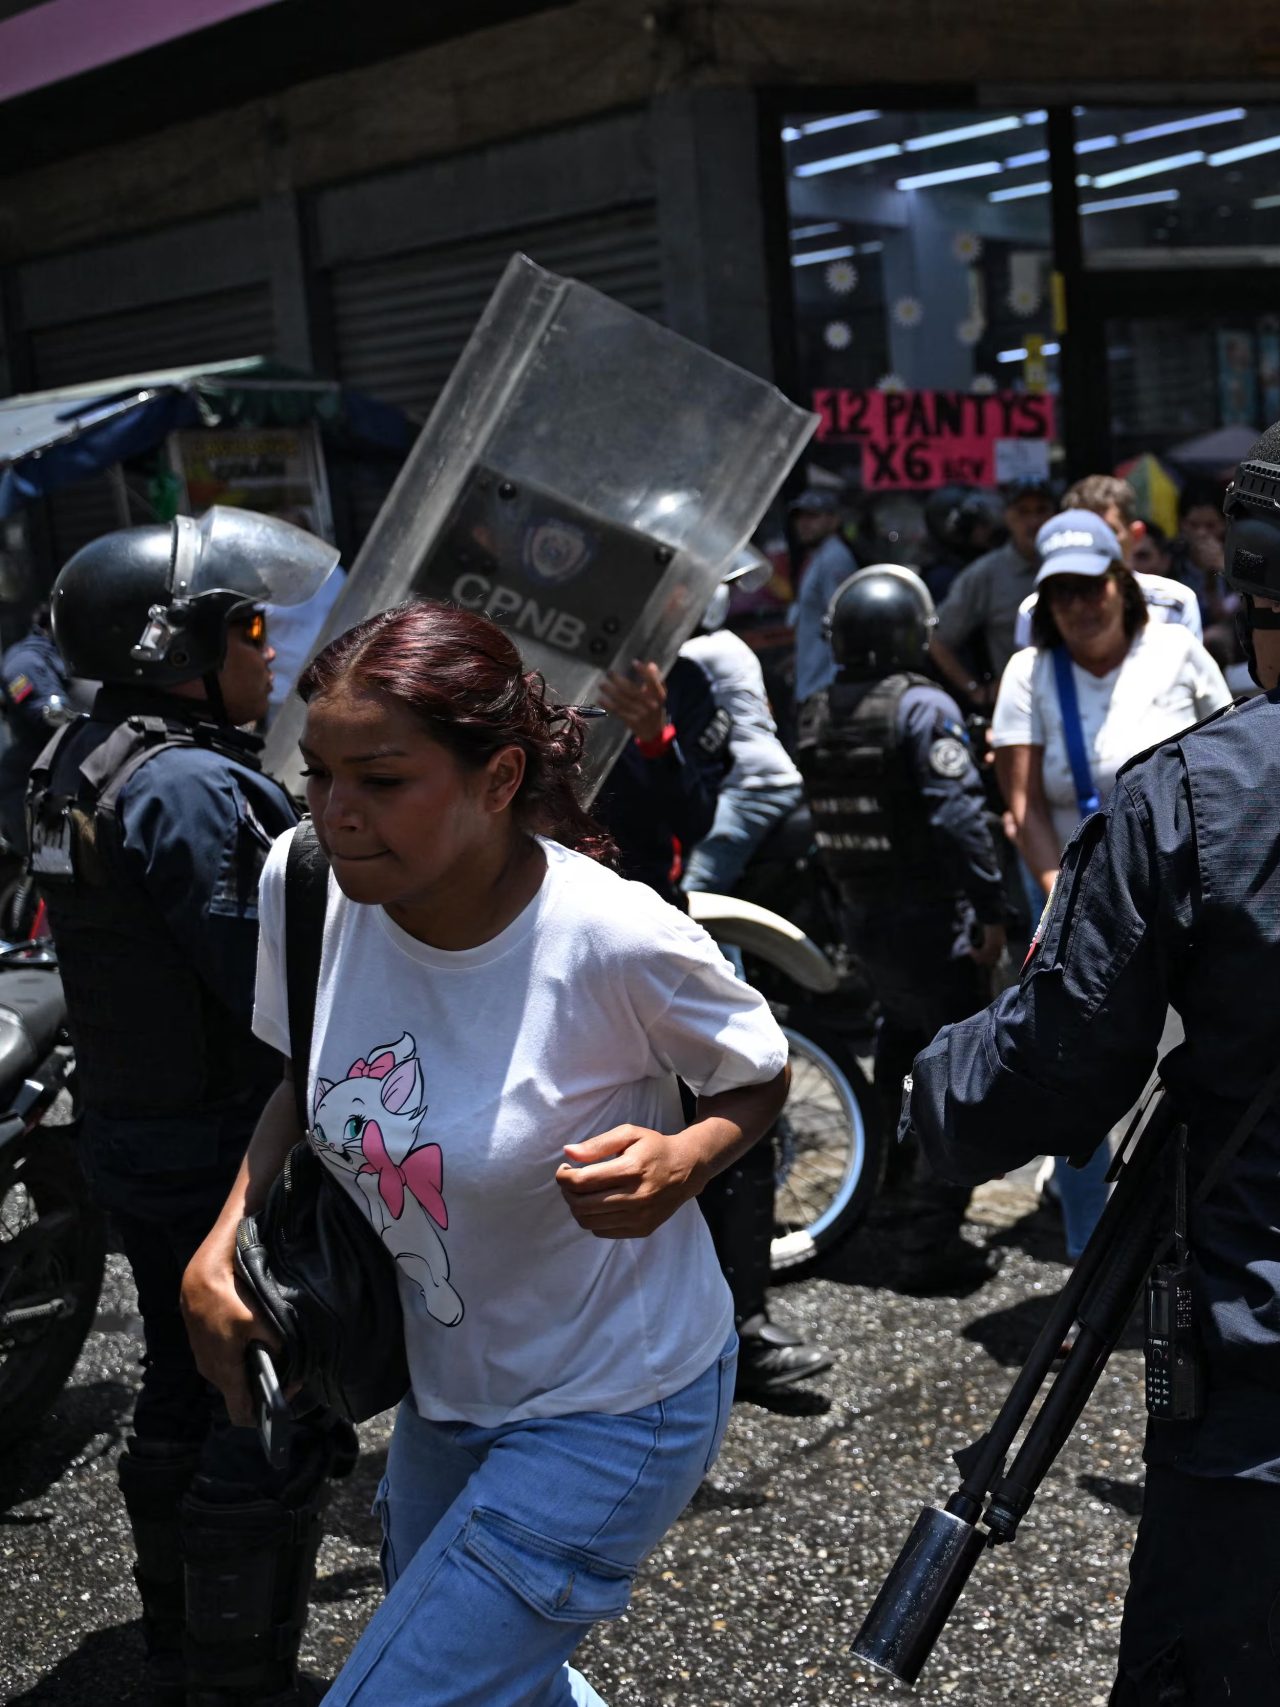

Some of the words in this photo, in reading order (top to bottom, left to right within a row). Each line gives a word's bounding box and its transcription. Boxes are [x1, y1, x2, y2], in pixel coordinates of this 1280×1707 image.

[821, 394, 870, 436] 12
[882, 393, 1047, 437] PANTYS
[868, 441, 933, 483] X6
[452, 573, 588, 650] CPNB
